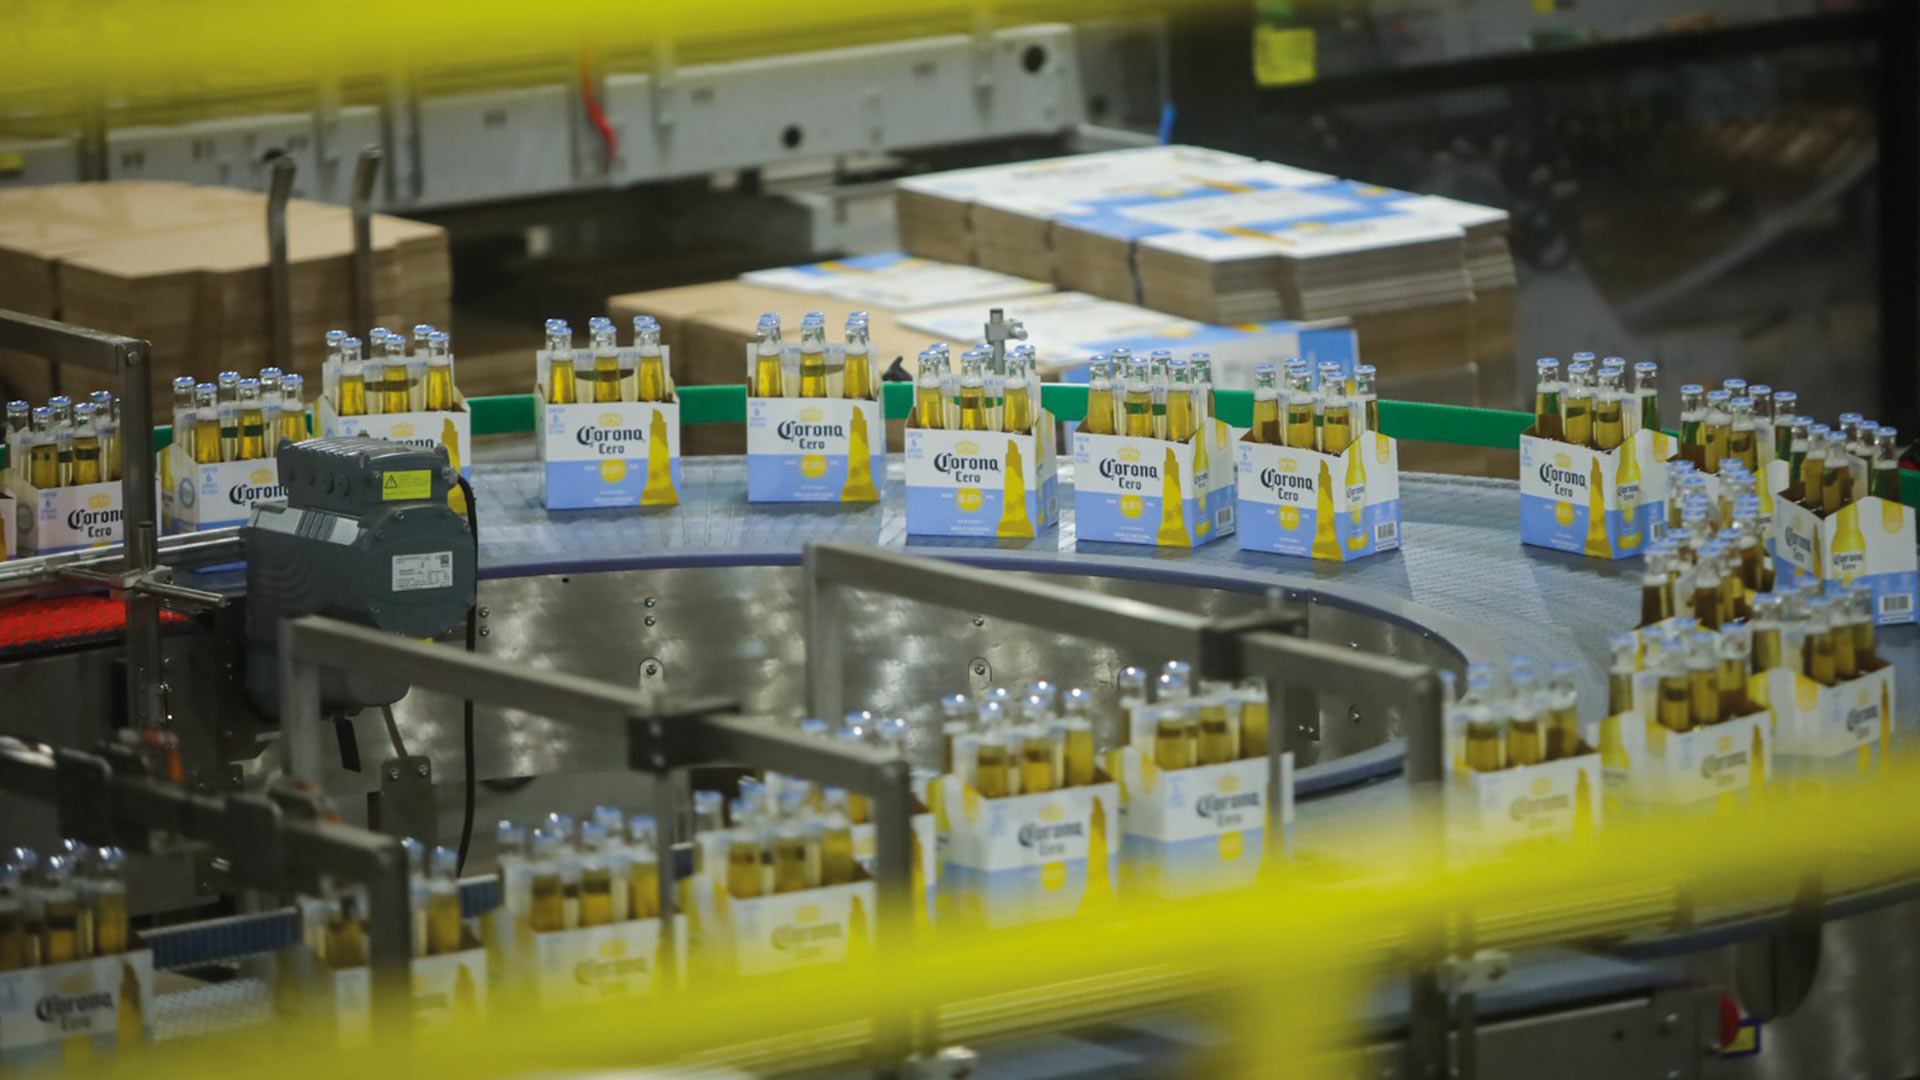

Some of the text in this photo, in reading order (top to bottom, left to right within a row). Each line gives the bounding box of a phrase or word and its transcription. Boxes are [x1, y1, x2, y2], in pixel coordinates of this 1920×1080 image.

[576, 425, 643, 447] Corona
[777, 420, 844, 442] Corona
[598, 443, 625, 455] Cero
[799, 438, 825, 450] Cero
[933, 451, 999, 474] Corona
[1099, 458, 1158, 480] Corona
[955, 471, 981, 483] Cero
[1260, 467, 1313, 491] Corona
[1539, 462, 1586, 486] Corona
[1119, 477, 1142, 490] Cero
[1555, 483, 1573, 498] Cero
[1278, 487, 1299, 502] Cero
[68, 509, 122, 530] Coron
[88, 527, 112, 538] Cero
[1832, 553, 1863, 566] Corona
